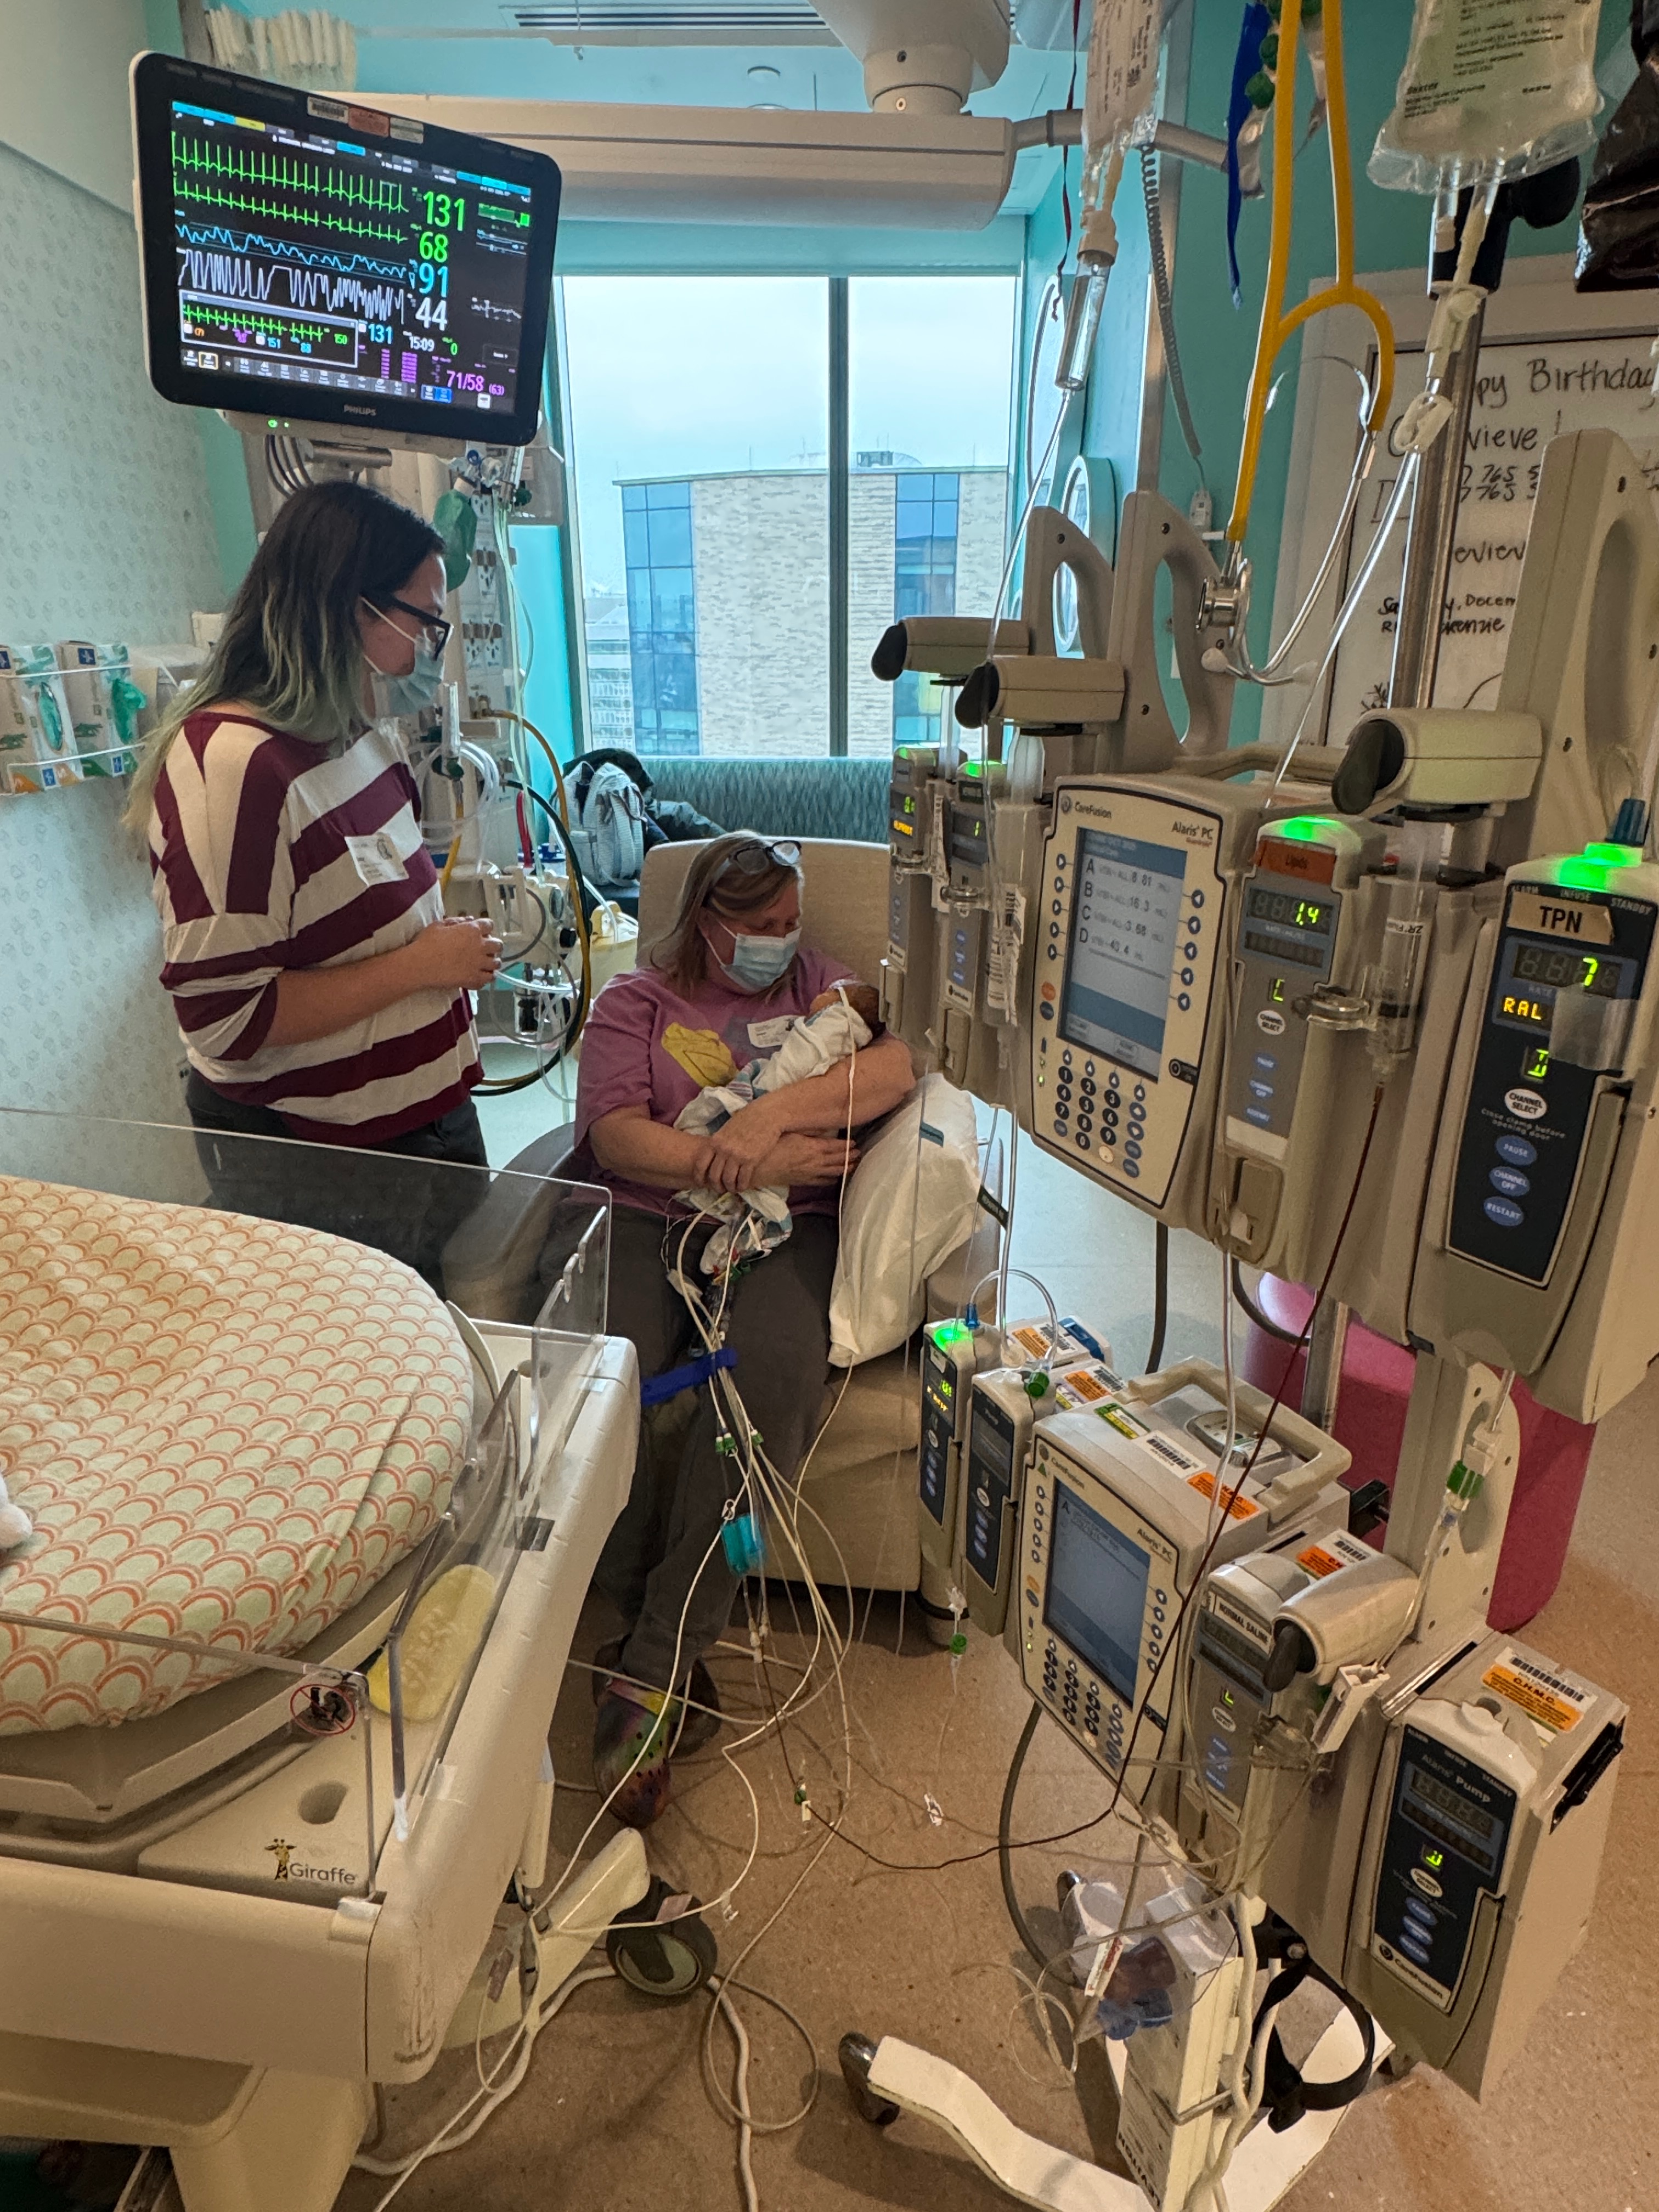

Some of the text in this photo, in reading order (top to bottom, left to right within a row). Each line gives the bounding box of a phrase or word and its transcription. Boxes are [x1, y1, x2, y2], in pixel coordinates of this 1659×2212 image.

[423, 191, 465, 232] 131
[419, 232, 449, 263] 68
[419, 262, 449, 297] 91
[415, 297, 448, 331] 44
[368, 323, 393, 345] 131
[409, 336, 435, 352] 15:09
[447, 370, 484, 392] 71/58
[343, 404, 376, 416] PHILIPS
[1075, 802, 1111, 819] CareFusion
[1201, 827, 1214, 839] PC
[1086, 859, 1094, 874] A
[1084, 881, 1093, 897] B
[1082, 905, 1091, 920] C
[1296, 902, 1319, 926] 1.4
[1611, 898, 1652, 915] STANDBY
[1539, 905, 1583, 933] TPN
[1080, 928, 1088, 943] D
[1582, 957, 1598, 987] 7
[1503, 997, 1542, 1020] RAL
[1509, 1092, 1543, 1109] CHANNEL
[1512, 1101, 1538, 1115] SELECT
[1504, 1143, 1527, 1158] PAUSE
[1493, 1170, 1527, 1187] CHANNEL
[1487, 1203, 1521, 1220] RESTART
[1219, 1602, 1268, 1645] NORMAL SALINE
[1456, 1775, 1491, 1803] Pump
[290, 1862, 356, 1885] Giraffe
